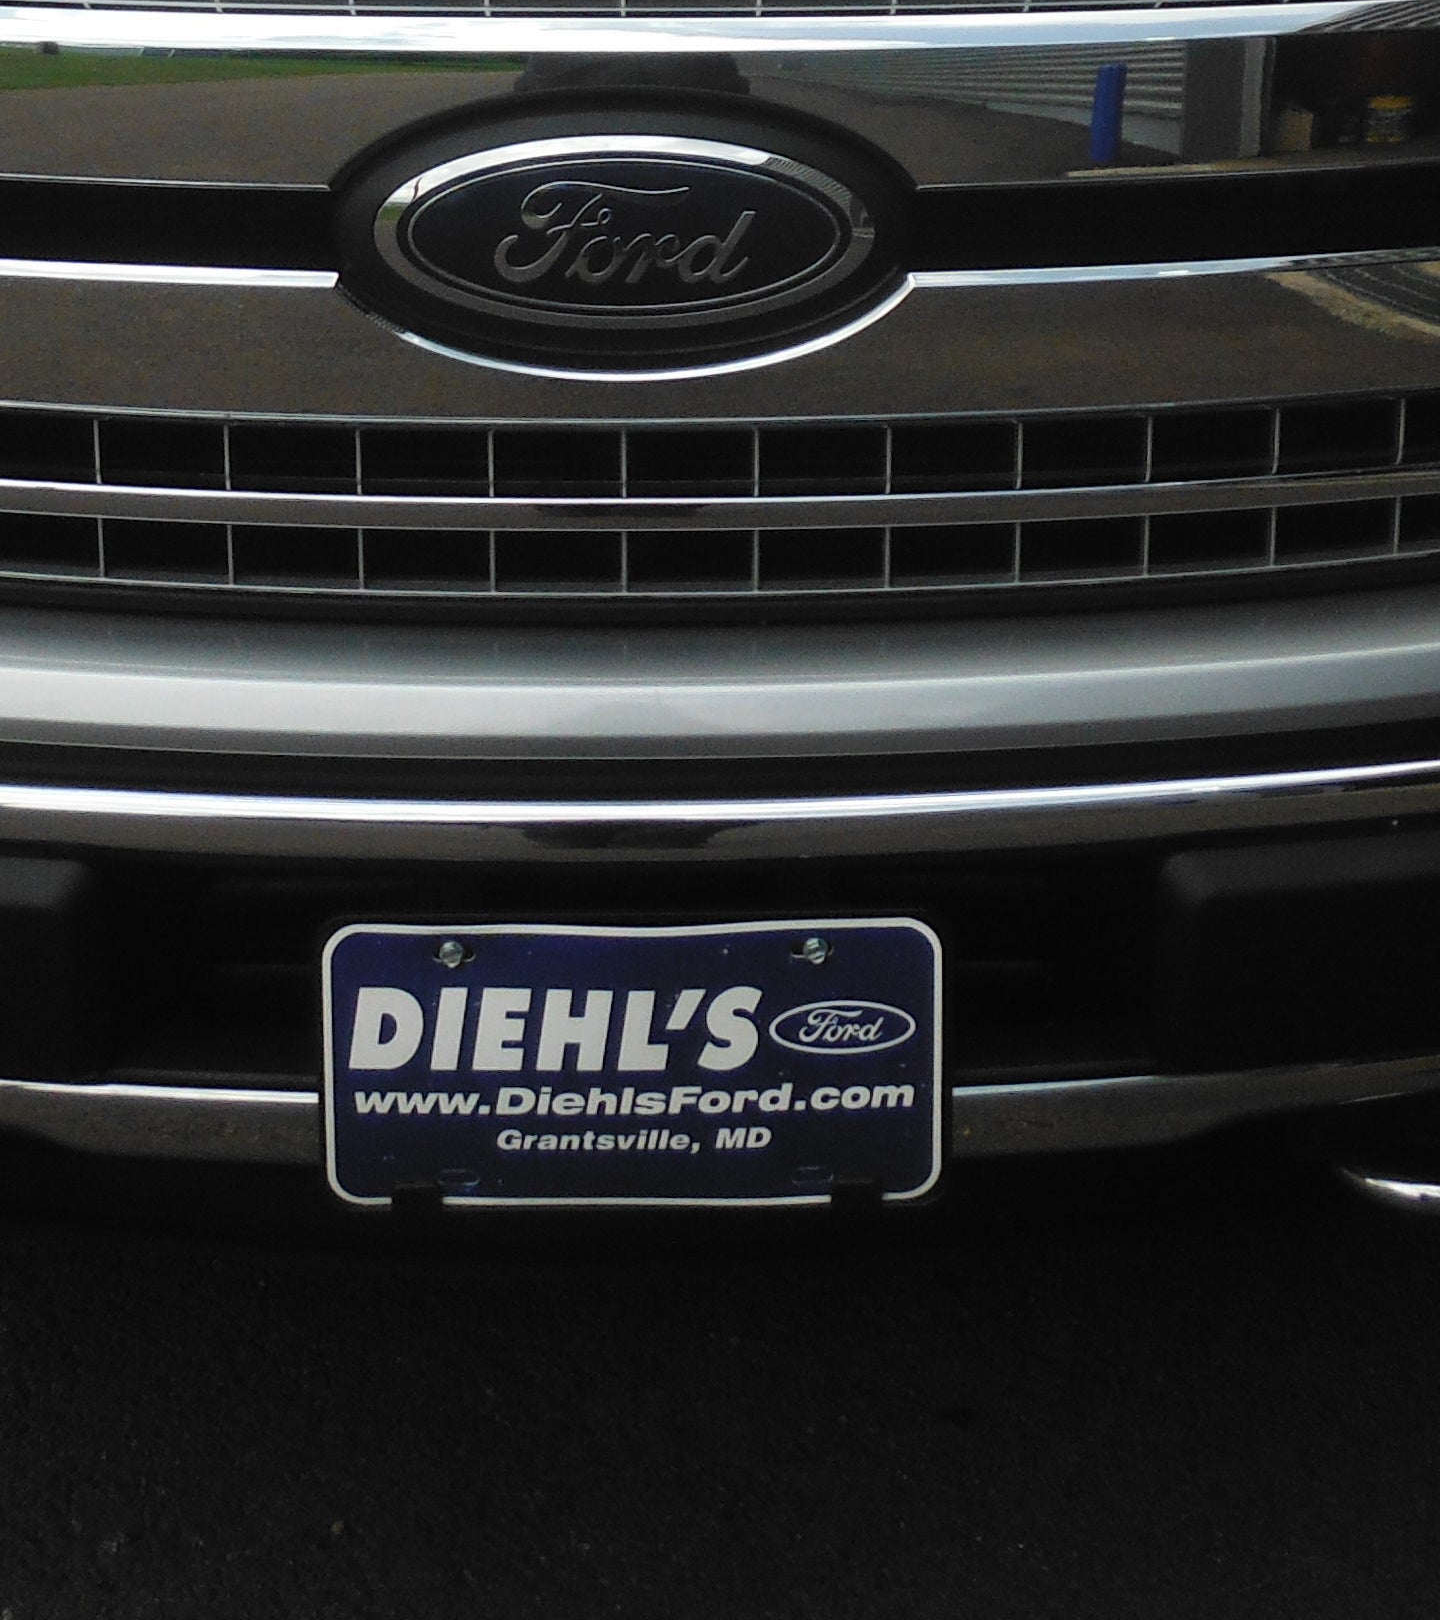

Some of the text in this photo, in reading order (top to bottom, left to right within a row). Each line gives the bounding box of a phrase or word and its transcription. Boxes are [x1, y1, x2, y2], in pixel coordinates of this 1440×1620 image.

[495, 180, 757, 283] Ford
[349, 986, 763, 1071] DIEHL'S
[798, 1008, 885, 1042] Ford
[354, 1083, 915, 1116] www.DiehlsFord.com
[496, 1126, 772, 1154] Grantsville, MD
